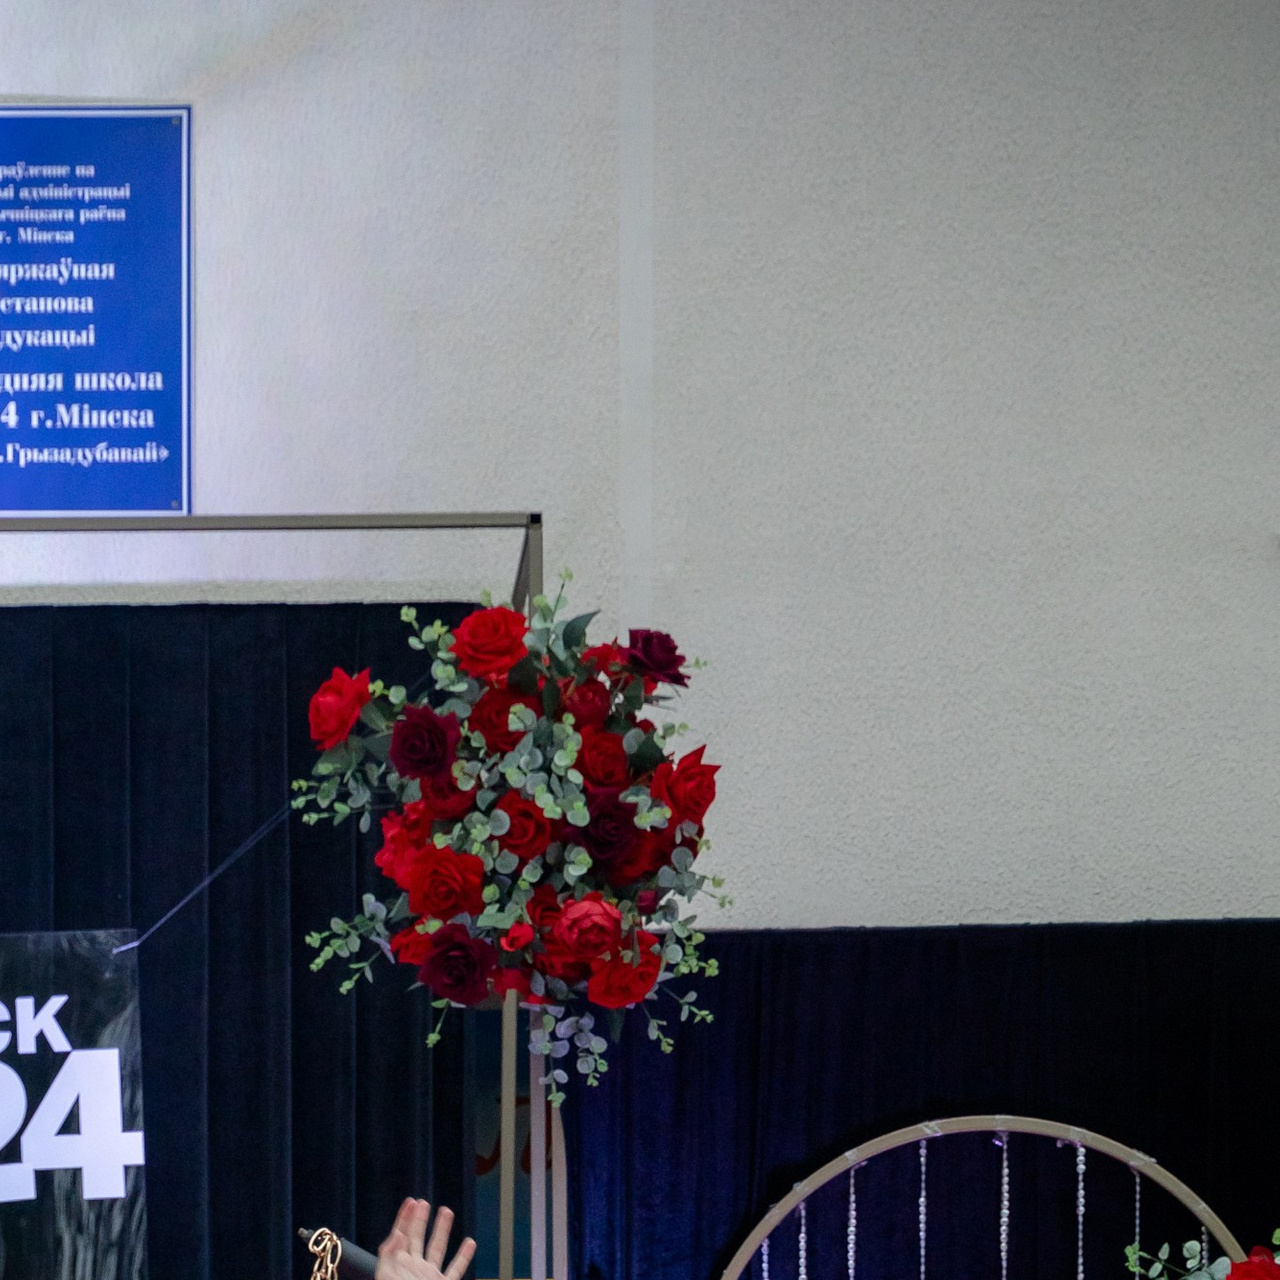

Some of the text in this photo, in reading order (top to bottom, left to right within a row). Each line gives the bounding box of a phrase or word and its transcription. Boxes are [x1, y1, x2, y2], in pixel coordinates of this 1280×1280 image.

[75, 164, 95, 178] па
[19, 183, 131, 204] адміністрацыі
[80, 205, 126, 225] раёна
[18, 227, 75, 244] Мінска
[74, 371, 164, 391] школа
[30, 403, 155, 429] г.Мінска
